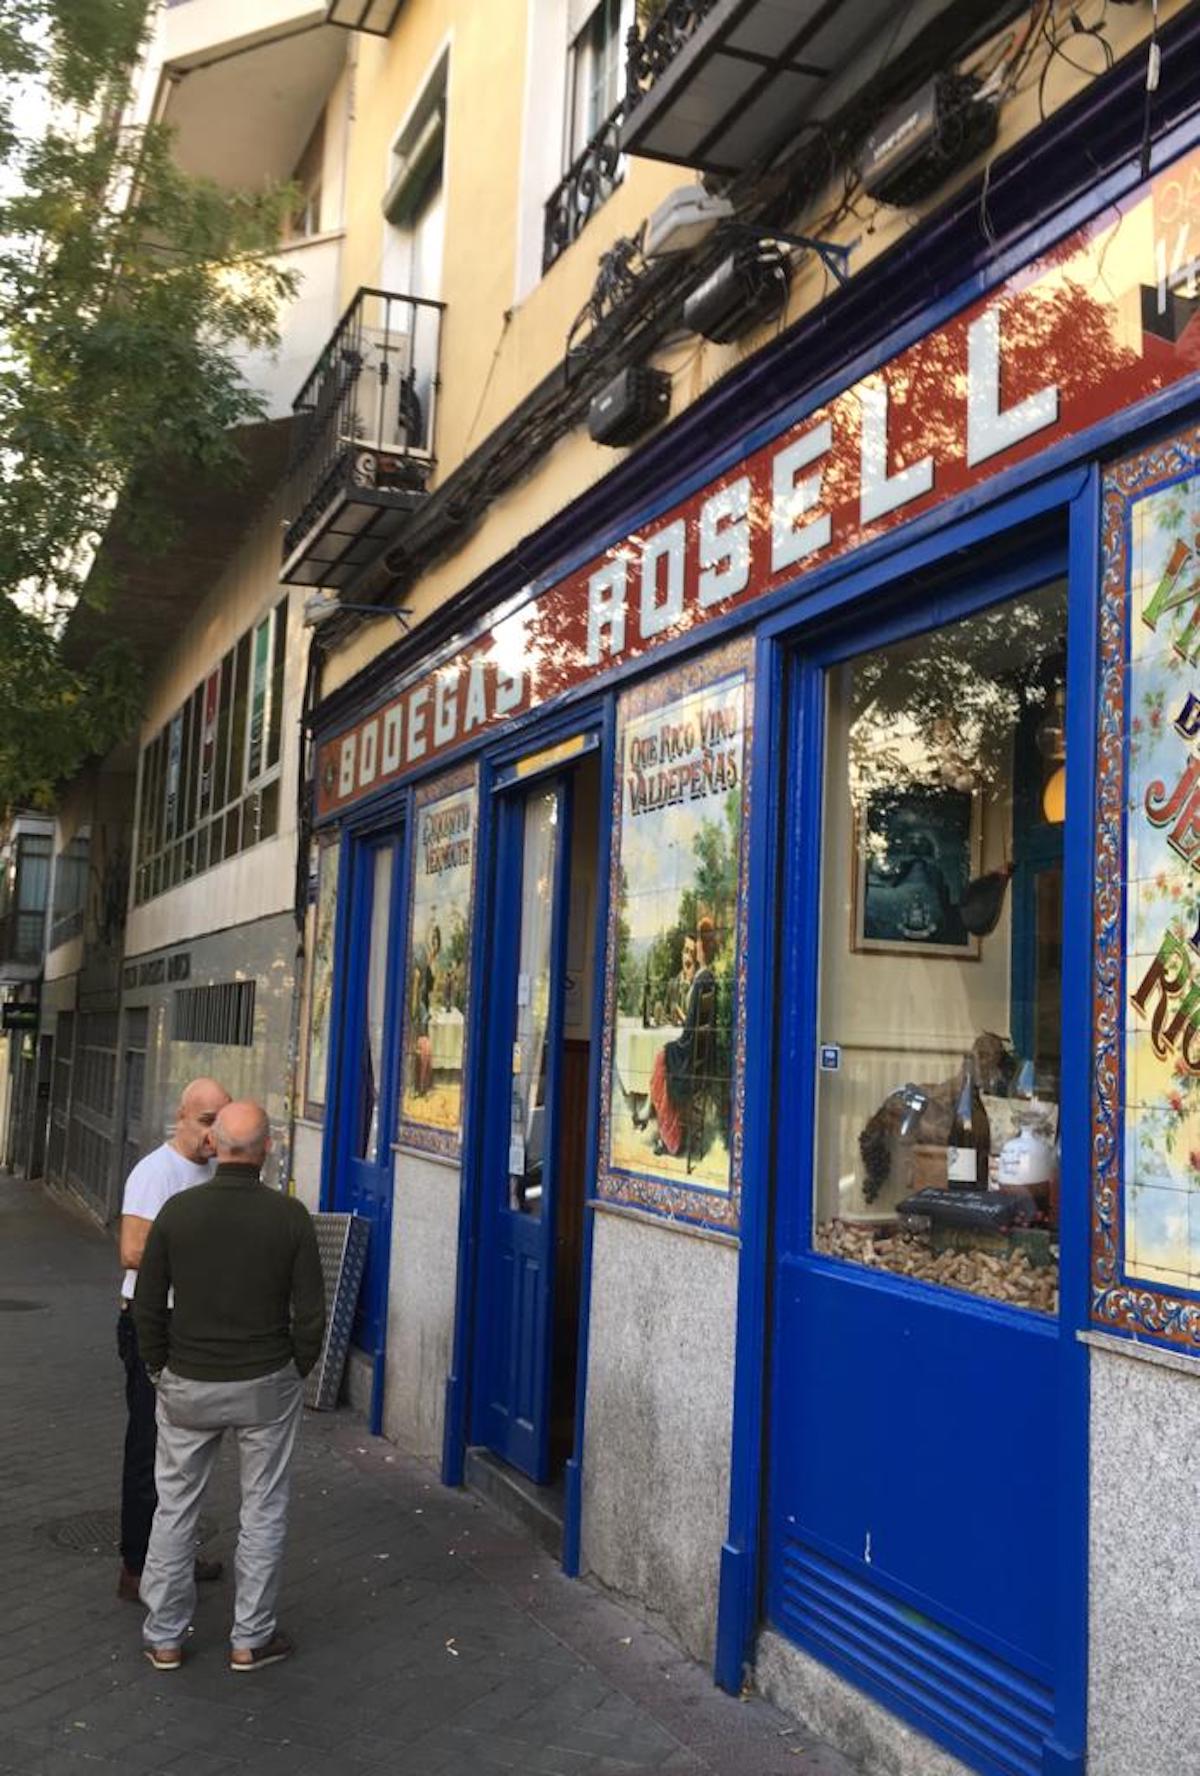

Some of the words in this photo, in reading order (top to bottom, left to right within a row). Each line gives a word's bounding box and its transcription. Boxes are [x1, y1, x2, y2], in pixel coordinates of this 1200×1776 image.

[338, 643, 525, 798] BODEGAS
[586, 305, 1060, 667] ROSELL
[627, 747, 739, 816] VALDEPEÑAS
[630, 735, 658, 771] QUE
